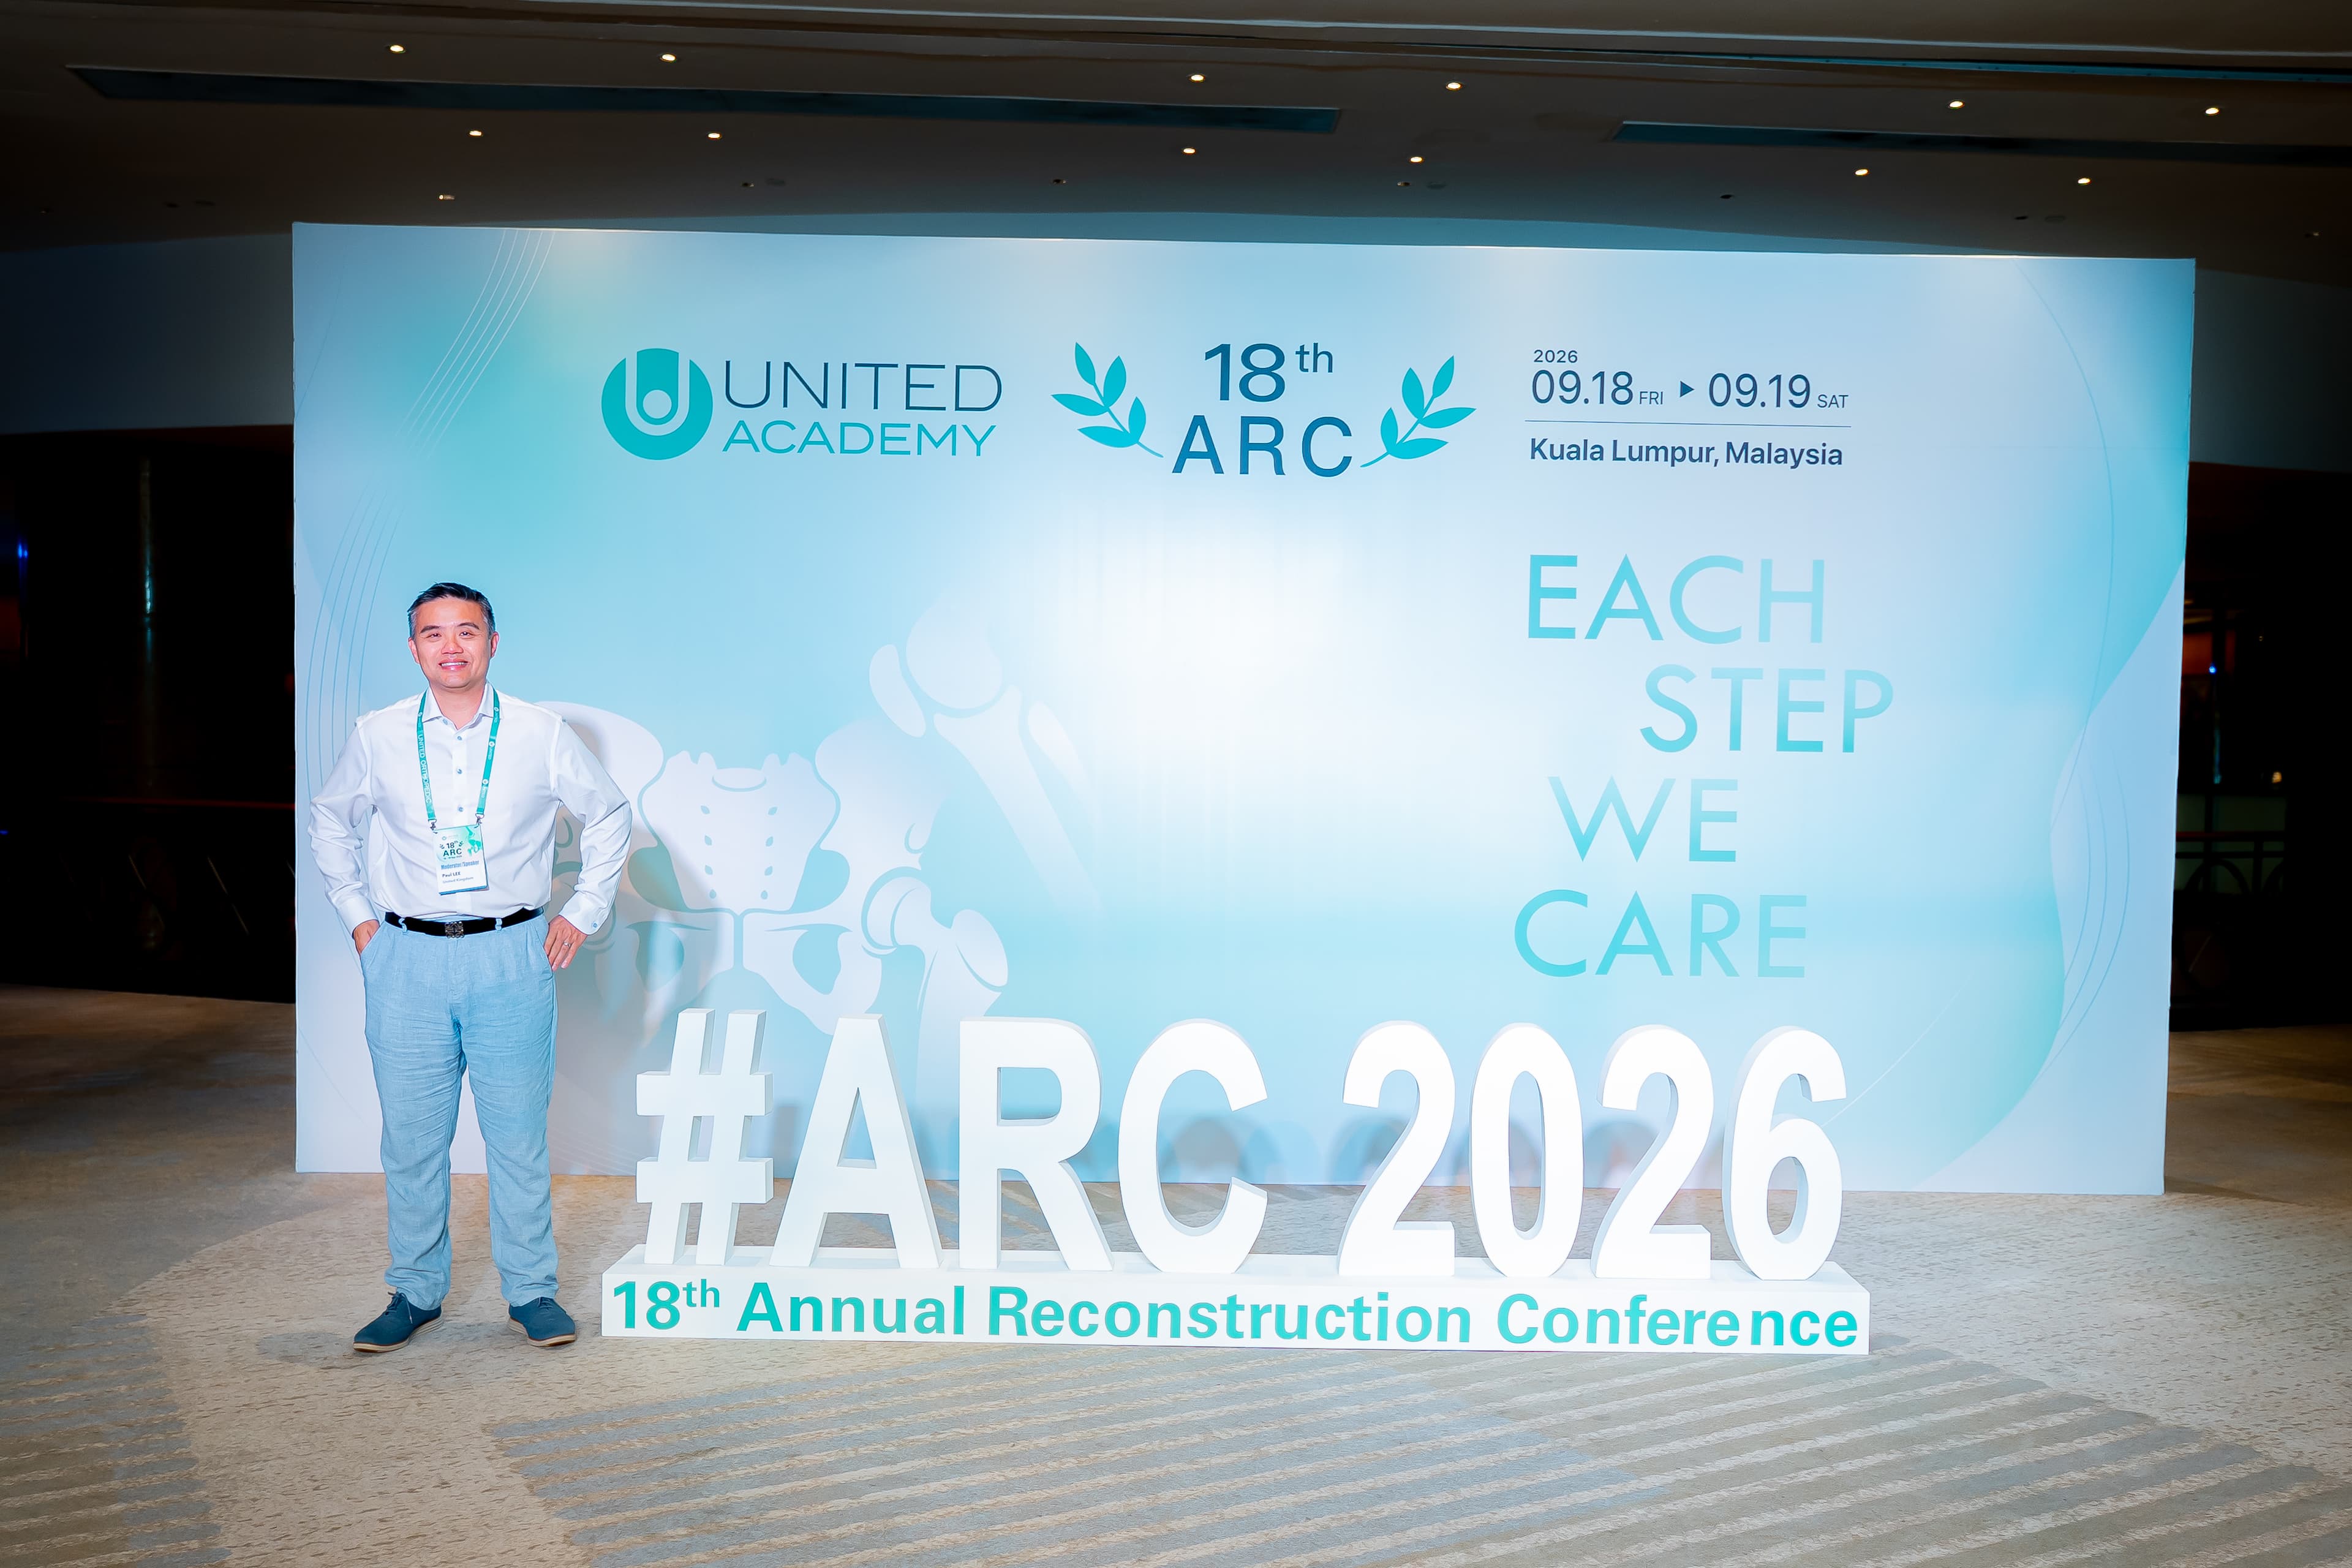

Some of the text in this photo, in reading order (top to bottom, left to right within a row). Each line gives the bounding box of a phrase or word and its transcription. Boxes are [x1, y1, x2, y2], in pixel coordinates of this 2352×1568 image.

[725, 360, 1002, 412] UNITED
[1204, 342, 1333, 402] 18th
[1533, 349, 1578, 363] 2026
[1532, 369, 1849, 409] 09.18 FRI 09.19 SAT
[722, 420, 997, 457] ACADEMY
[1172, 415, 1352, 477] ARC
[1531, 437, 1844, 469] Kuala Lumpur, Malaysia
[1528, 554, 1825, 644] EACH
[1640, 663, 1894, 753] STEP
[420, 759, 432, 804] ORTHOPEDIC
[1547, 775, 1738, 862] WE
[1514, 889, 1807, 978] CARE
[636, 1008, 1847, 1281] #ARC 2026
[612, 1278, 1858, 1346] 18th Annual Reconstruction Conference
